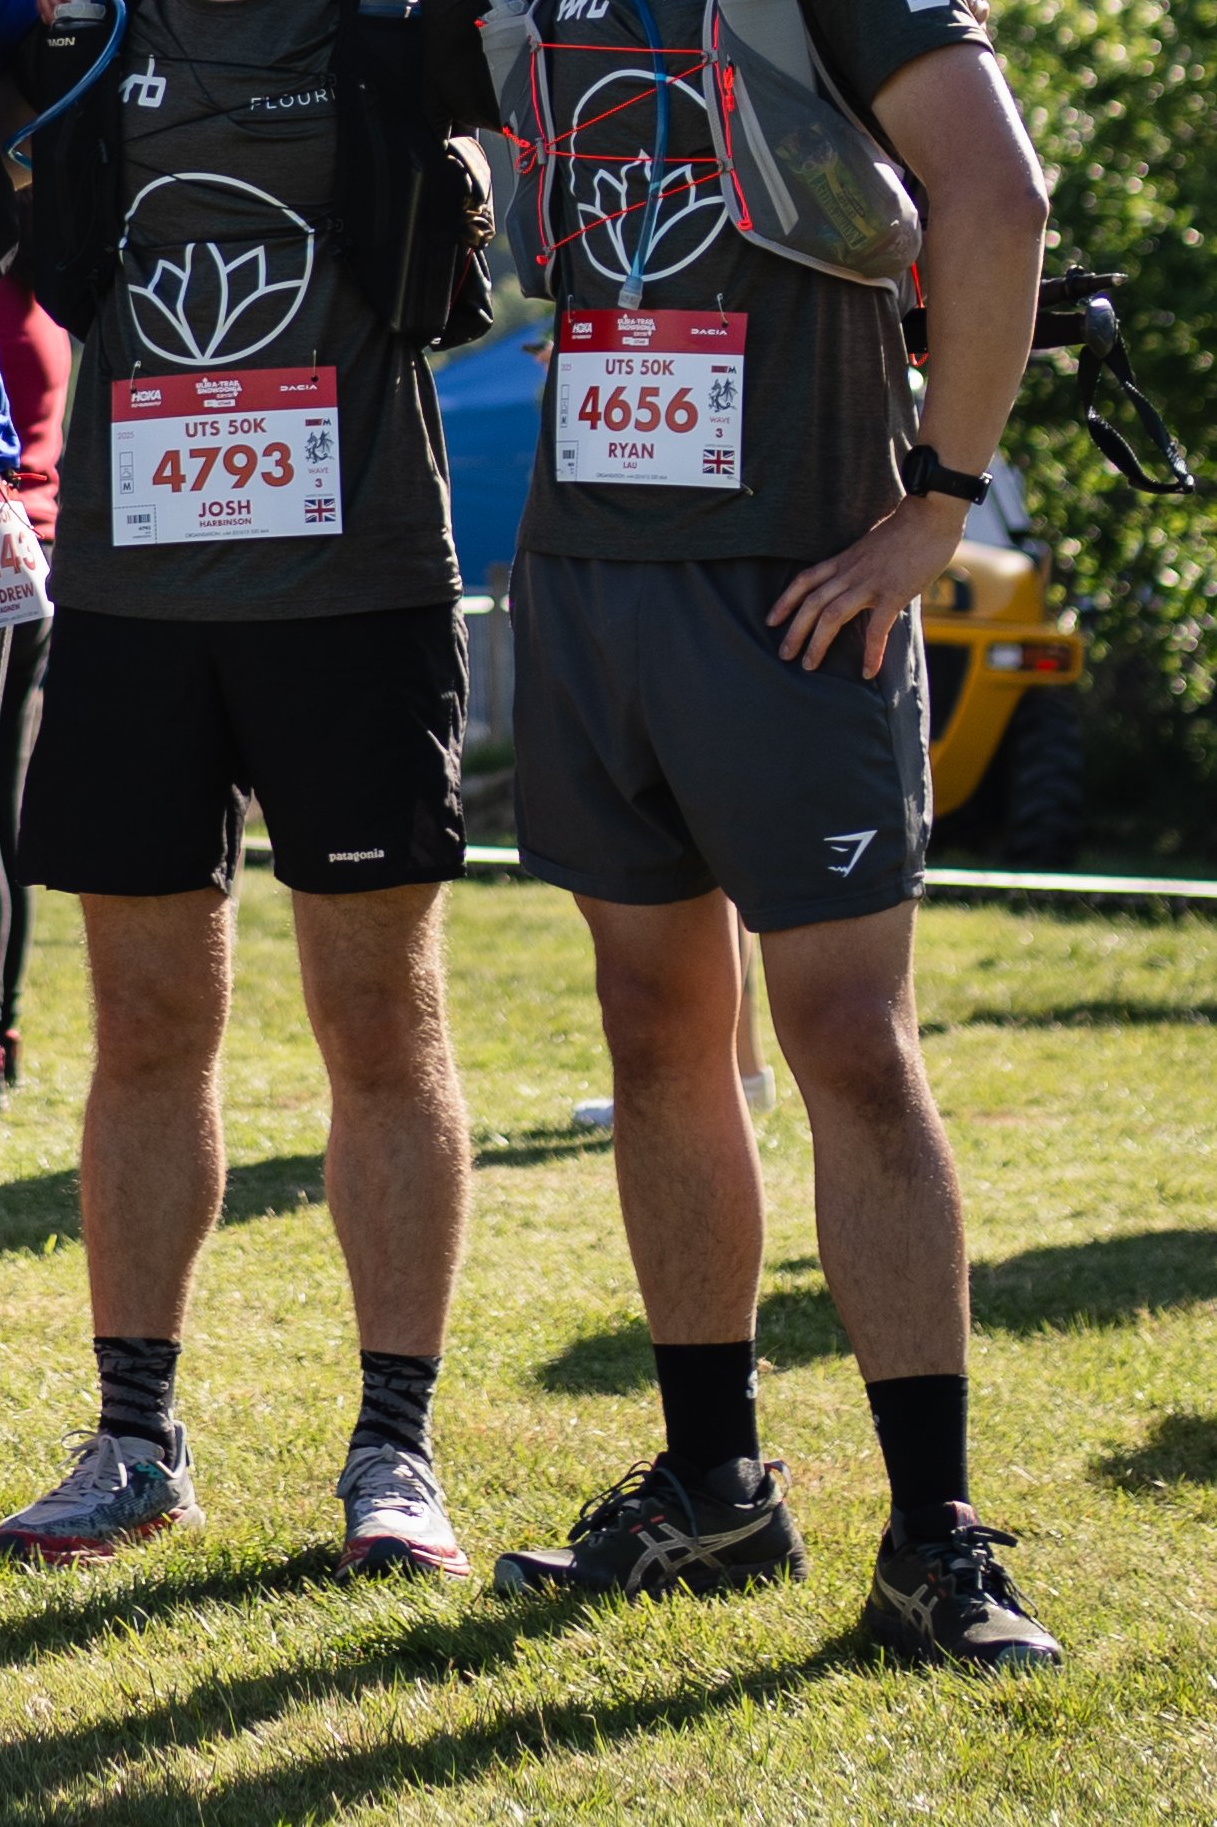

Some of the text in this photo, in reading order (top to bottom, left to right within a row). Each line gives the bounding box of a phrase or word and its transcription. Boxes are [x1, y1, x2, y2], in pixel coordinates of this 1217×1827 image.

[251, 88, 335, 111] FLOURI
[605, 358, 675, 376] UTS 50K
[131, 389, 162, 402] HOKA
[578, 385, 699, 434] 4656
[185, 417, 267, 438] UTS 50K
[715, 428, 723, 438] 3
[608, 442, 654, 459] RYAN
[152, 441, 295, 493] 4793
[308, 466, 330, 474] WAVE
[123, 483, 132, 491] M
[315, 478, 323, 488] 3
[198, 499, 251, 518] JOSH
[199, 517, 252, 527] HARBINSON
[329, 848, 384, 863] patagonia
